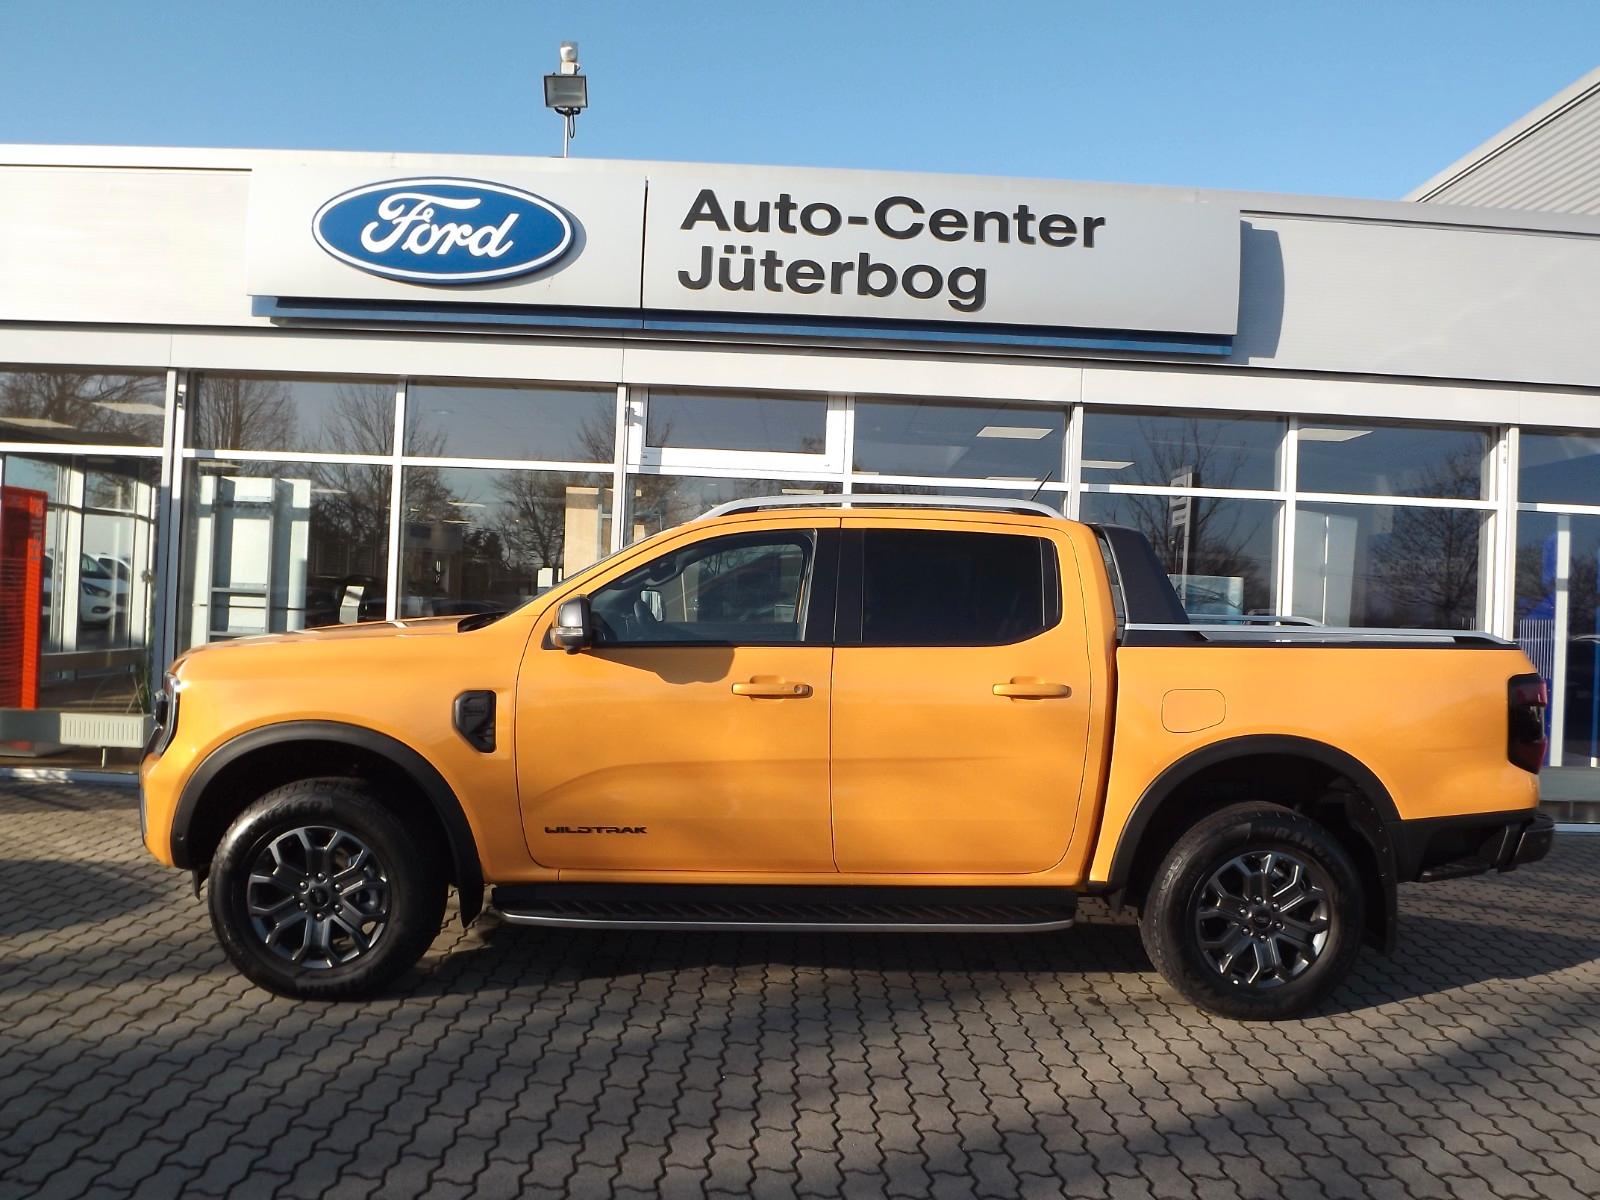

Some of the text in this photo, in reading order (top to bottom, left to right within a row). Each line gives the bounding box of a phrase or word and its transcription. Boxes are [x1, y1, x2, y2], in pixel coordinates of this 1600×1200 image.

[360, 192, 520, 258] Ford
[681, 189, 1106, 249] Auto-Center
[678, 244, 987, 312] Jüterbog
[544, 825, 648, 835] WILDTRAK
